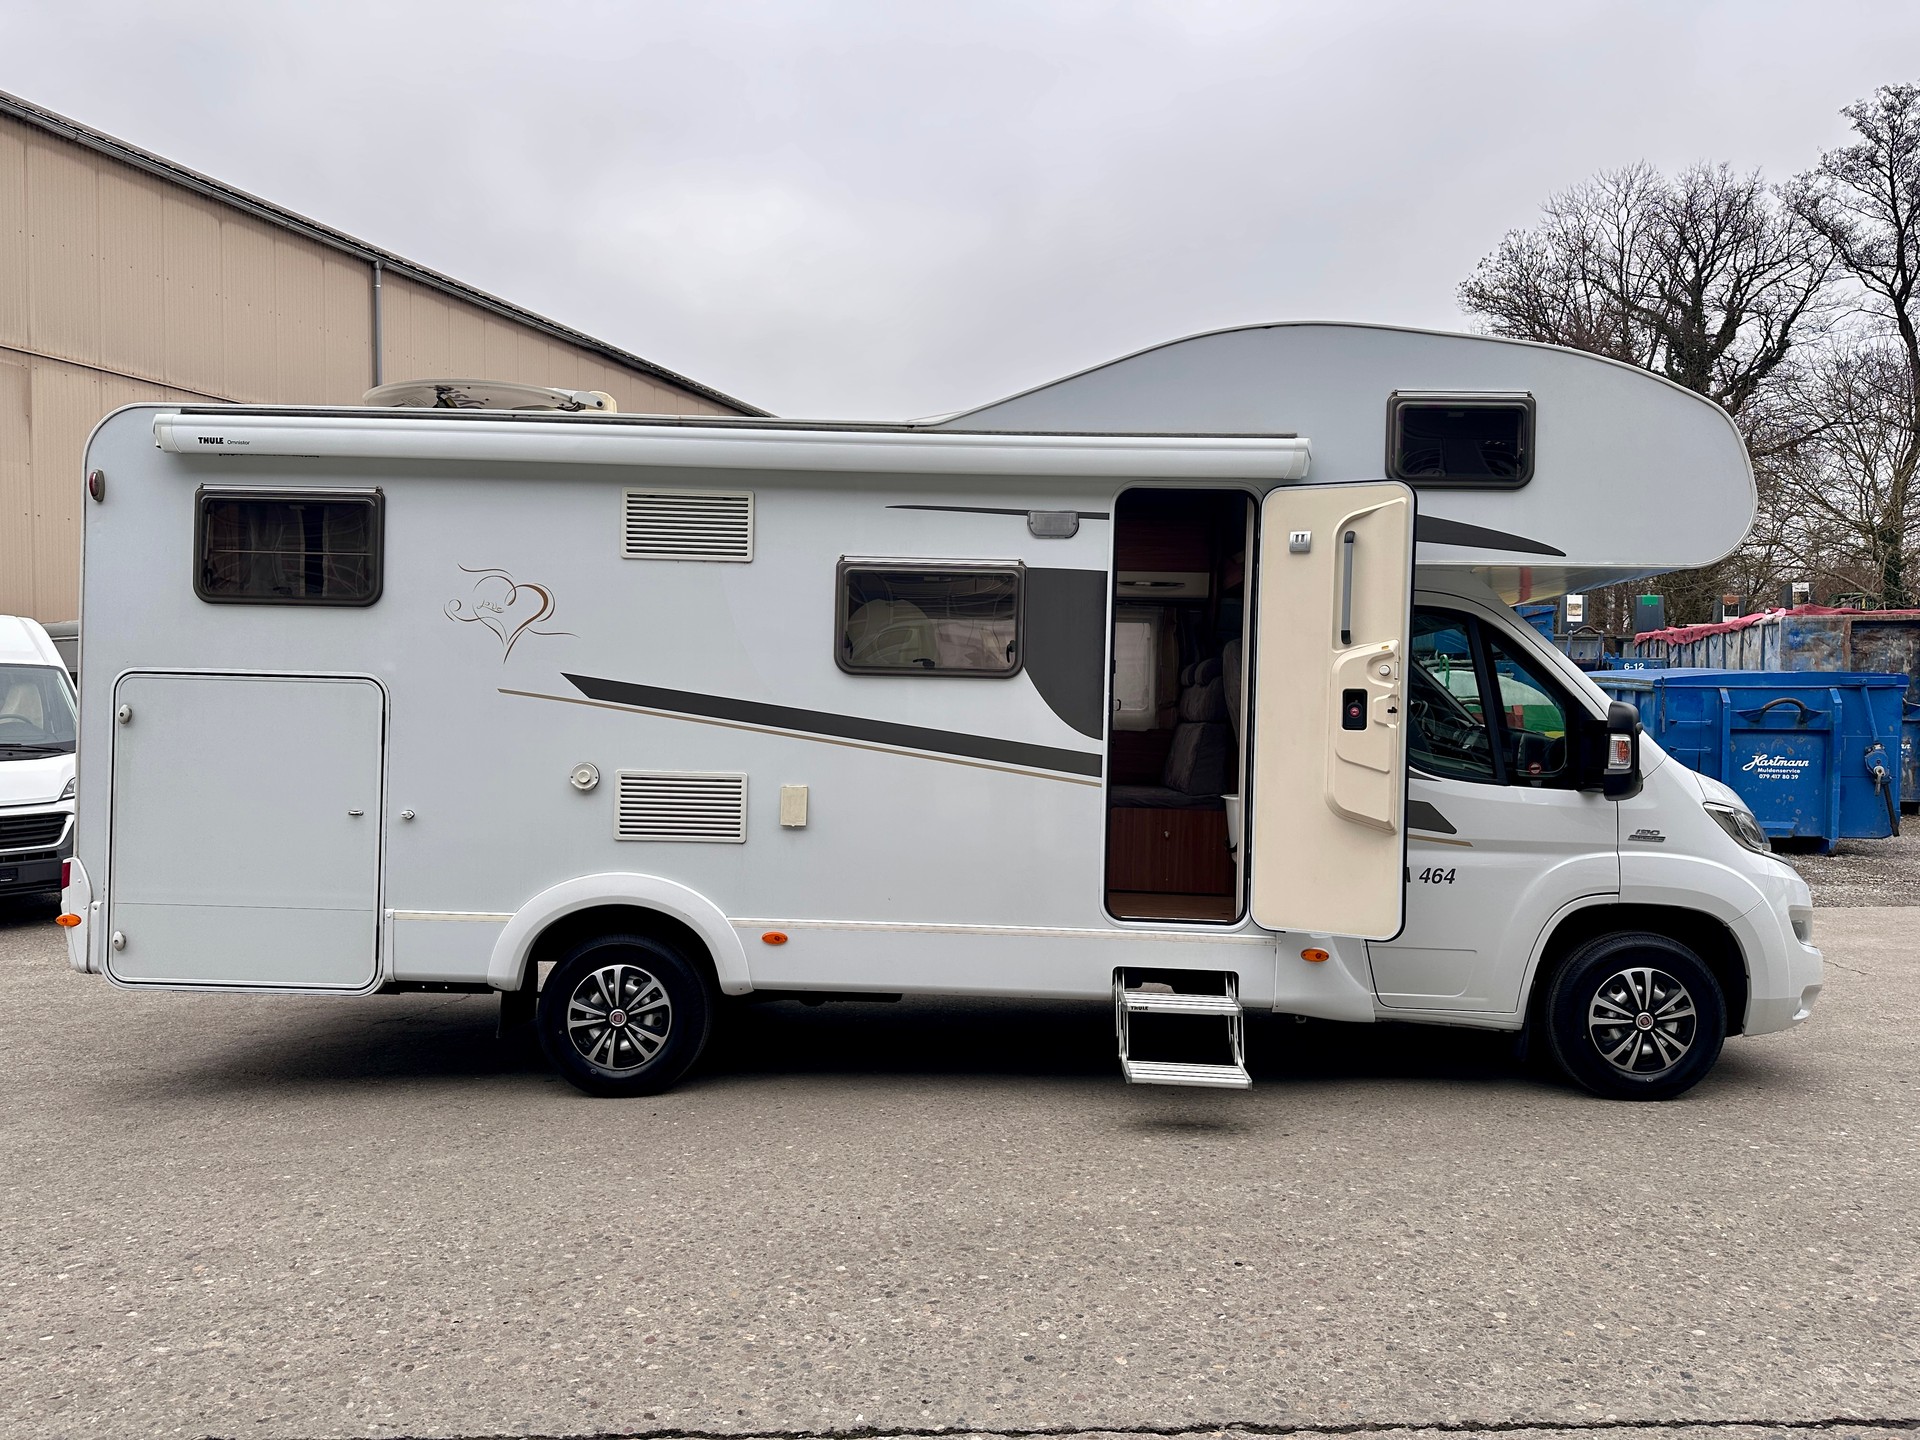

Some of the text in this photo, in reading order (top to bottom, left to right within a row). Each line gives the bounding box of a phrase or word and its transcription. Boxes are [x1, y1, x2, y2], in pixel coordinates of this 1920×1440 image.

[198, 437, 224, 445] THULE
[1624, 662, 1644, 671] 6-12
[1742, 754, 1809, 771] Hartmann
[1419, 867, 1456, 884] 464
